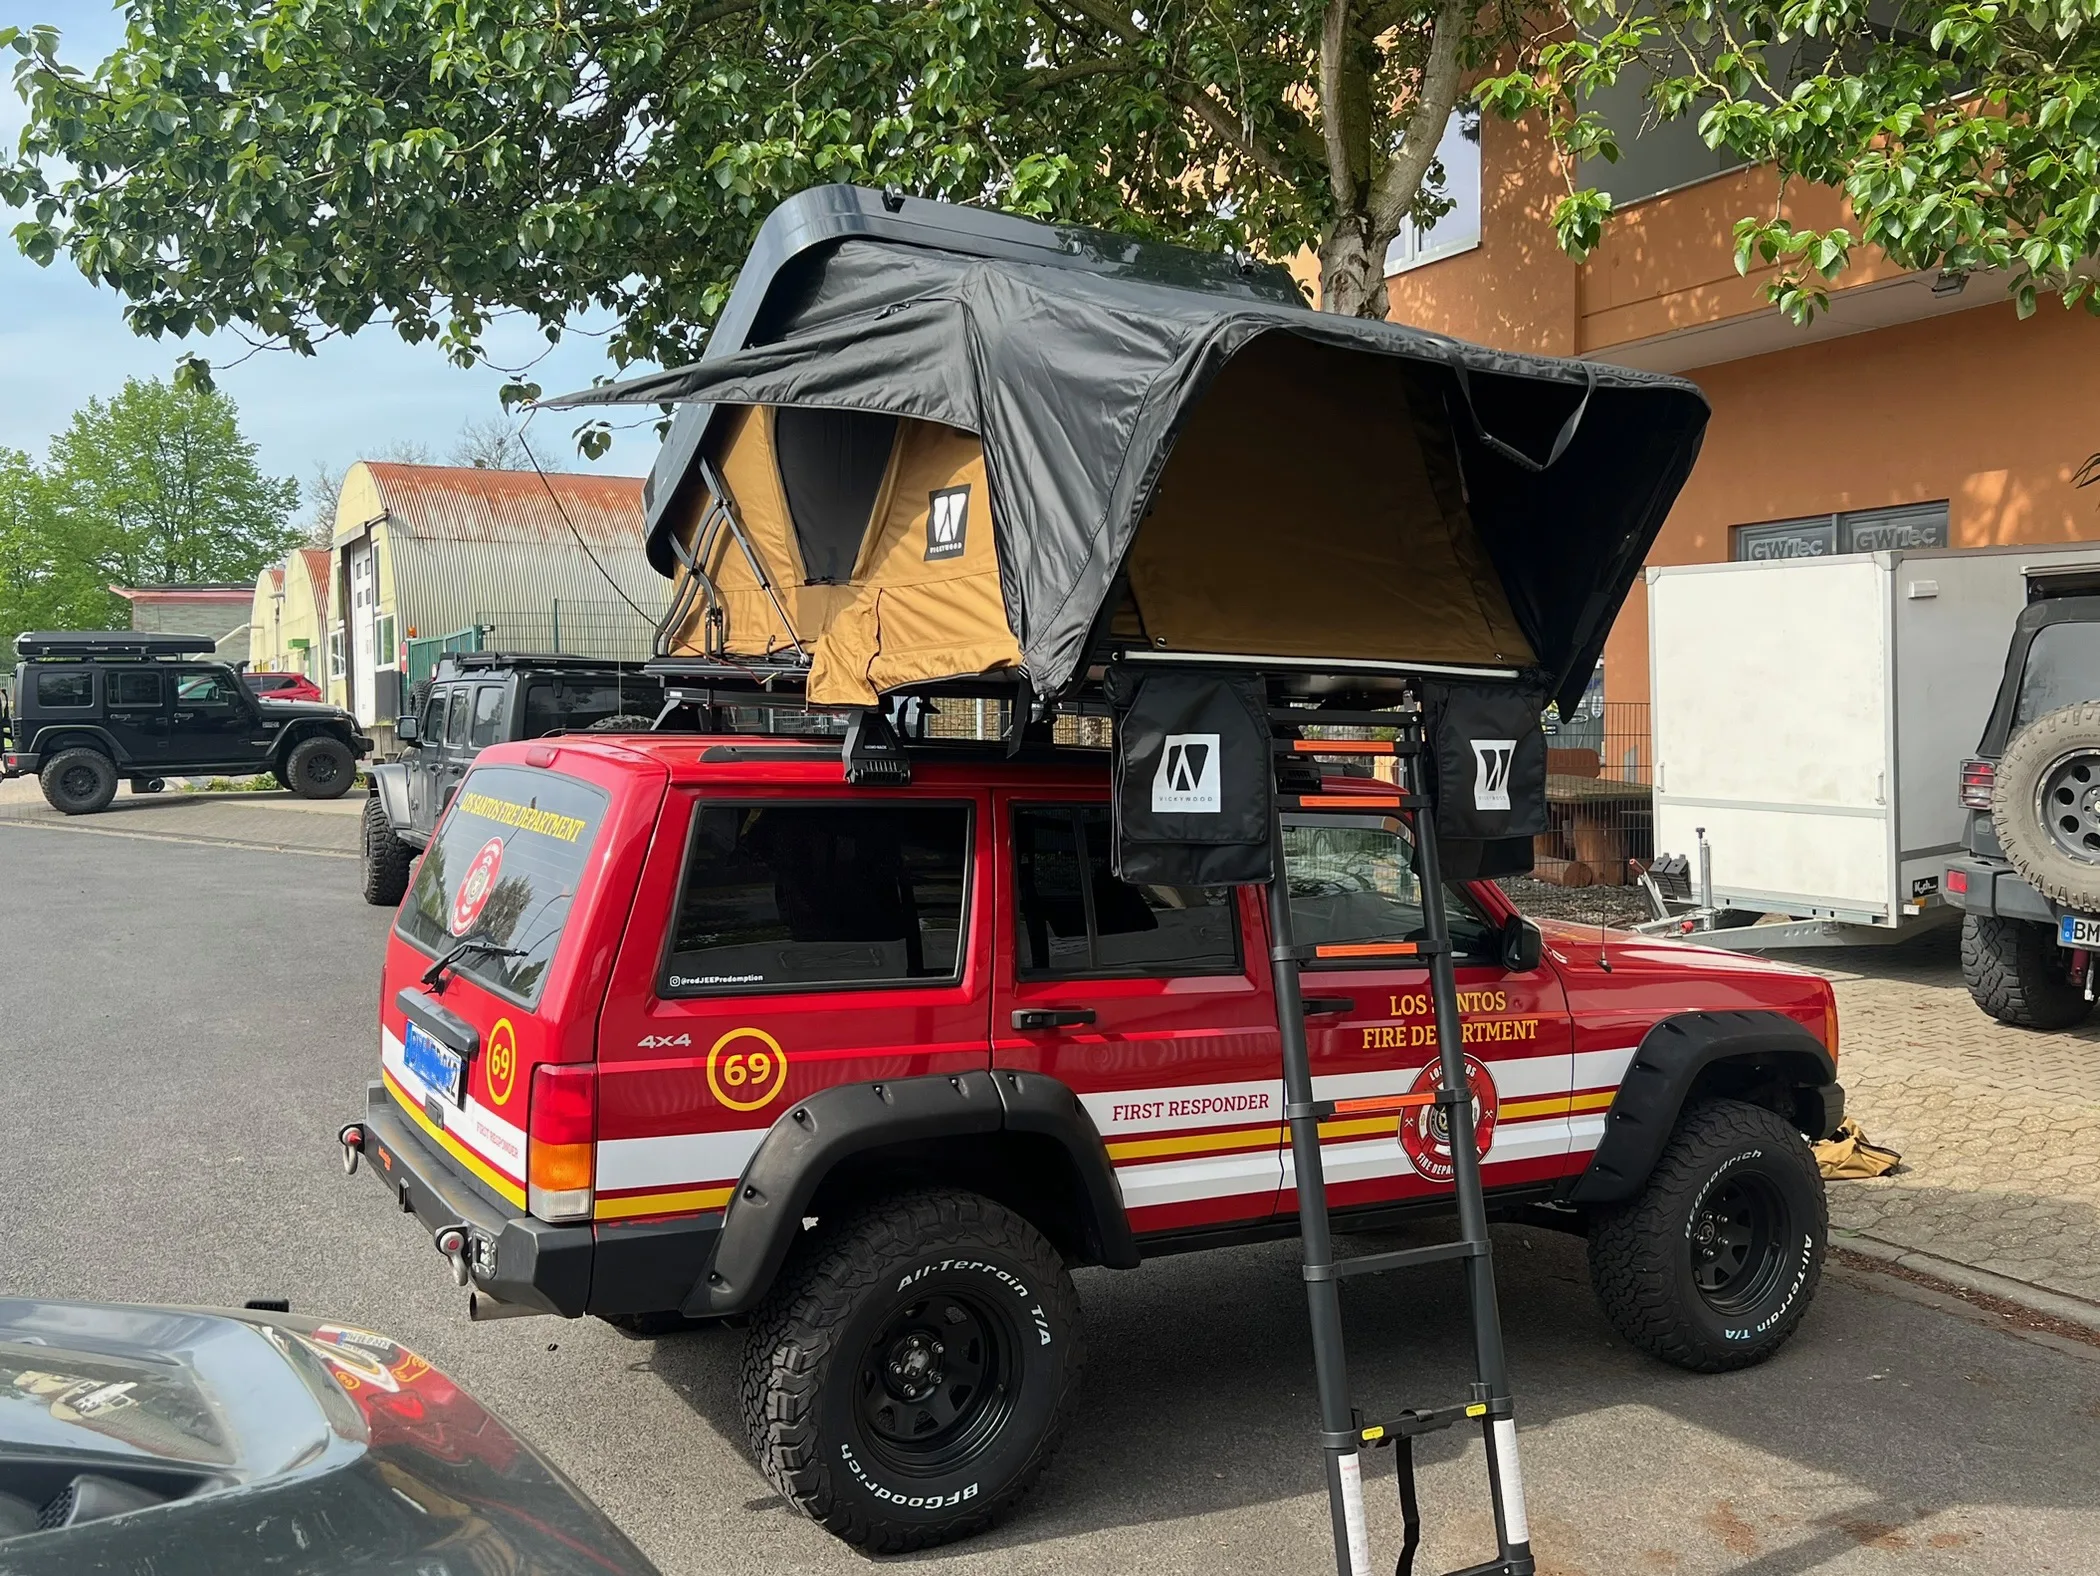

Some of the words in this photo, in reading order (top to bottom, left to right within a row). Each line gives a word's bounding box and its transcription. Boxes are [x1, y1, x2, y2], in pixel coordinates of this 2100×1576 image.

[1389, 995, 1428, 1016] LOS
[1430, 991, 1507, 1014] NTOS
[1362, 1027, 1407, 1049] FIRE
[1410, 1019, 1539, 1046] DERTMENT
[491, 1043, 510, 1080] 69
[724, 1052, 771, 1087] 69
[1112, 1102, 1165, 1122] FIRST
[1168, 1093, 1269, 1117] RESPONDER
[1416, 1152, 1433, 1171] FIRE
[1756, 1233, 1813, 1333] All-Terrain
[897, 1259, 1029, 1298] All-Terrain
[1030, 1304, 1052, 1346] T/A
[1725, 1328, 1751, 1340] T/A
[840, 1443, 979, 1510] BFGoodrich
